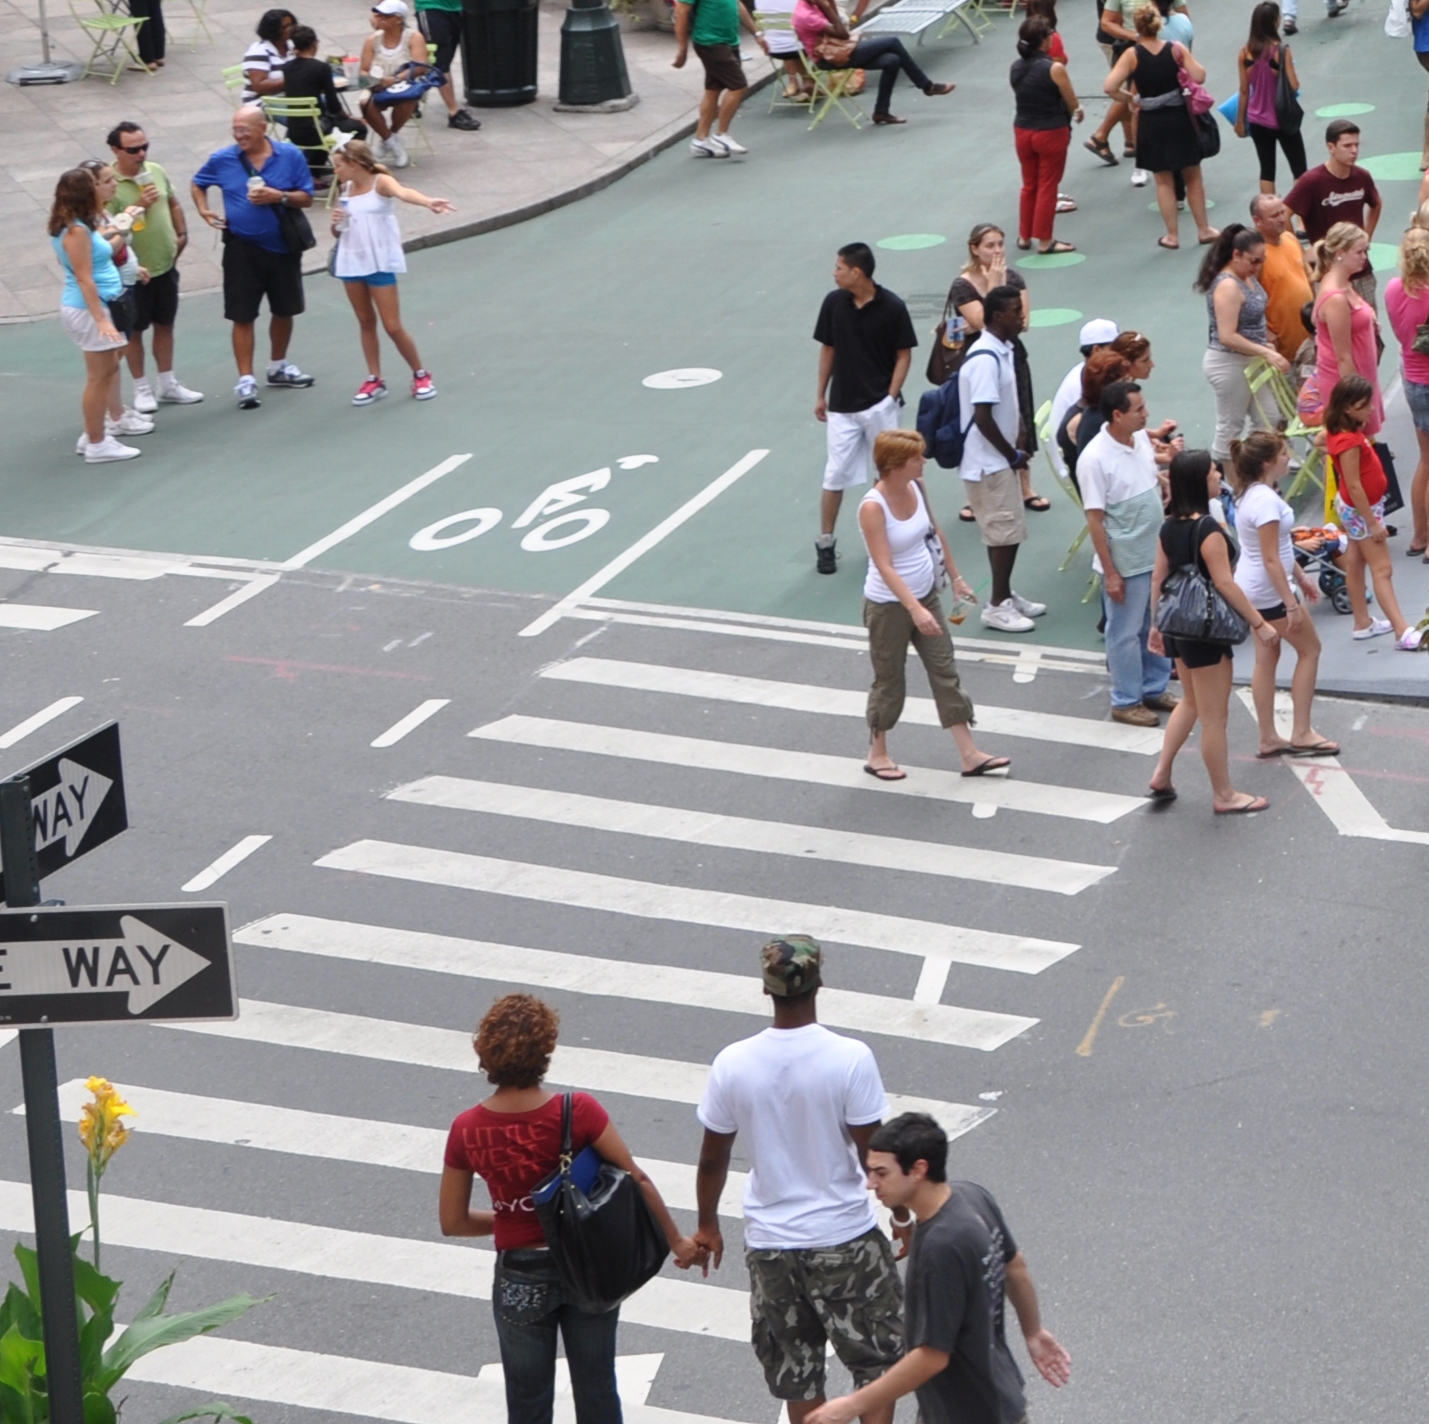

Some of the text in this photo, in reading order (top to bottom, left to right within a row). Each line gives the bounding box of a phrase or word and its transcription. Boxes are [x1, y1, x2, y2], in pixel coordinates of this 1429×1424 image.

[33, 775, 89, 843] WAY
[62, 943, 172, 989] WAY
[462, 1122, 548, 1148] LITTLE
